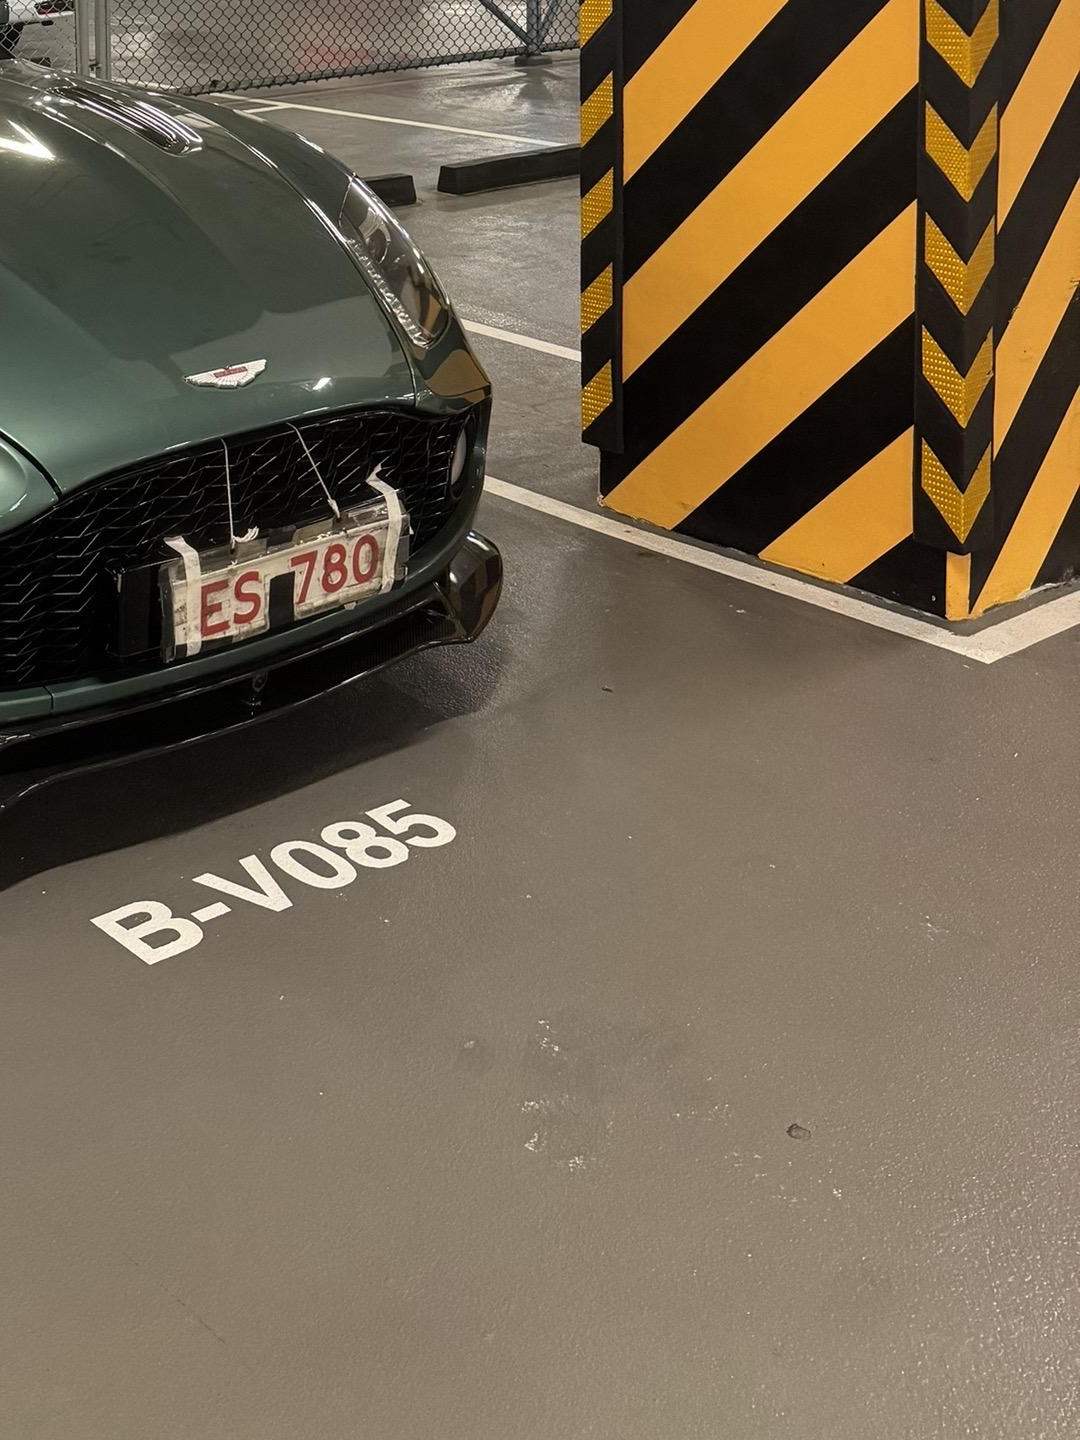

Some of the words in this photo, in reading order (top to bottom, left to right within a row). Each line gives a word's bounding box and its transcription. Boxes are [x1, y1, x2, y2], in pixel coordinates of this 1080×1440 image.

[201, 571, 261, 637] ES
[291, 534, 379, 605] 780
[90, 799, 457, 965] B-V085
